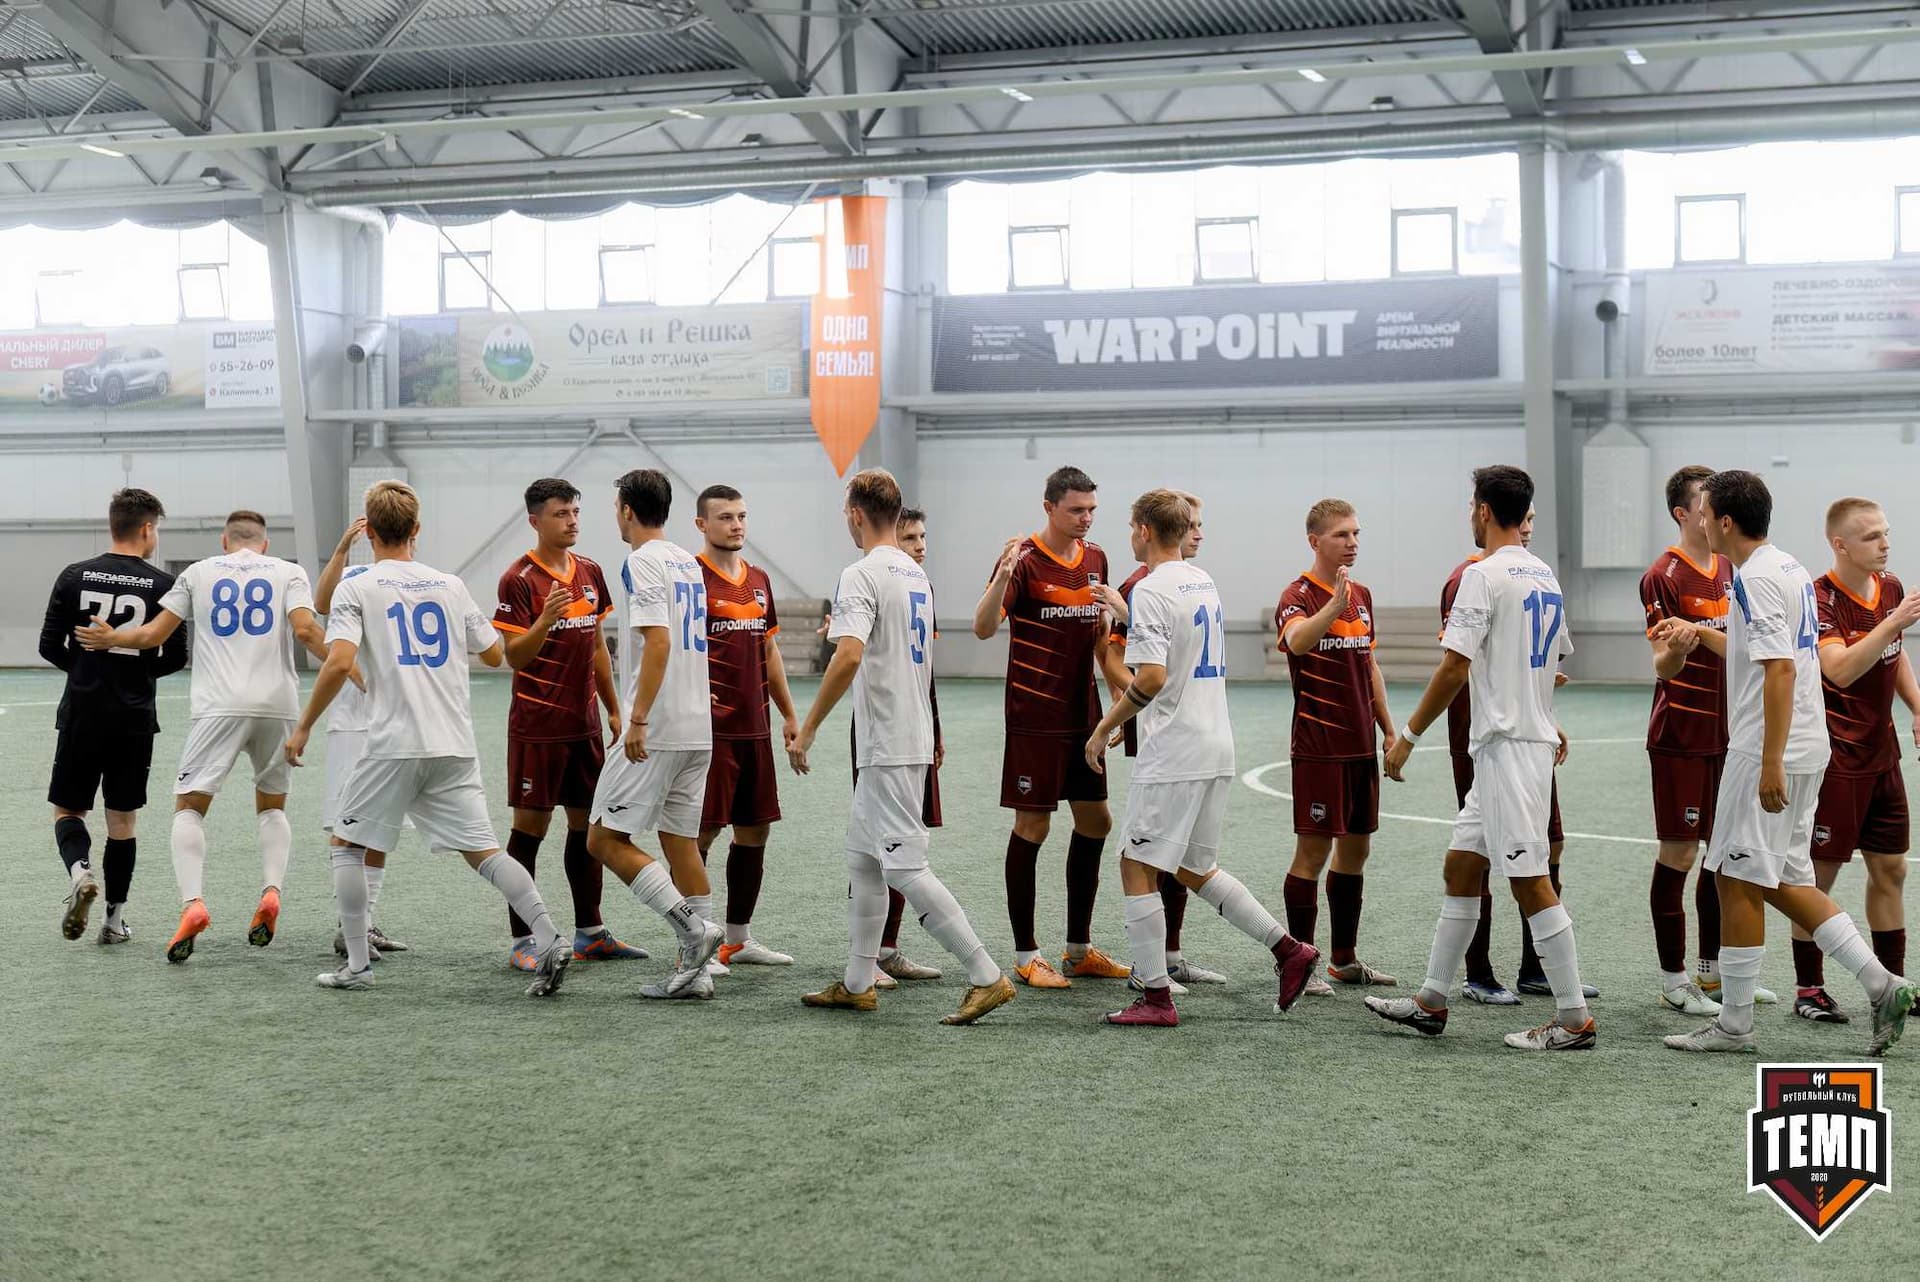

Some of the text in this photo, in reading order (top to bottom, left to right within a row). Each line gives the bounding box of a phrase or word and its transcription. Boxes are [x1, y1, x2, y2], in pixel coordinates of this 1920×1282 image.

[1376, 311, 1414, 324] АРЕНА
[1772, 312, 1839, 325] ДЕТСКИЙ
[823, 315, 868, 345] ОДНА
[1376, 320, 1461, 337] ВИРТУАЛЬНОЙ
[60, 337, 104, 353] ДИЛЕР
[1376, 336, 1454, 351] РЕАЛЬНОСТИ
[1655, 344, 1705, 358] более
[11, 355, 50, 369] CHERY
[219, 359, 274, 372] 55-26-09
[650, 352, 709, 367] отдыха
[816, 351, 875, 376] СЕМЬЯ!
[211, 578, 273, 637] 88
[80, 590, 147, 656] 72
[674, 582, 707, 652] 75
[387, 601, 450, 668] 19
[908, 591, 927, 665] 5
[1523, 590, 1563, 668] 17
